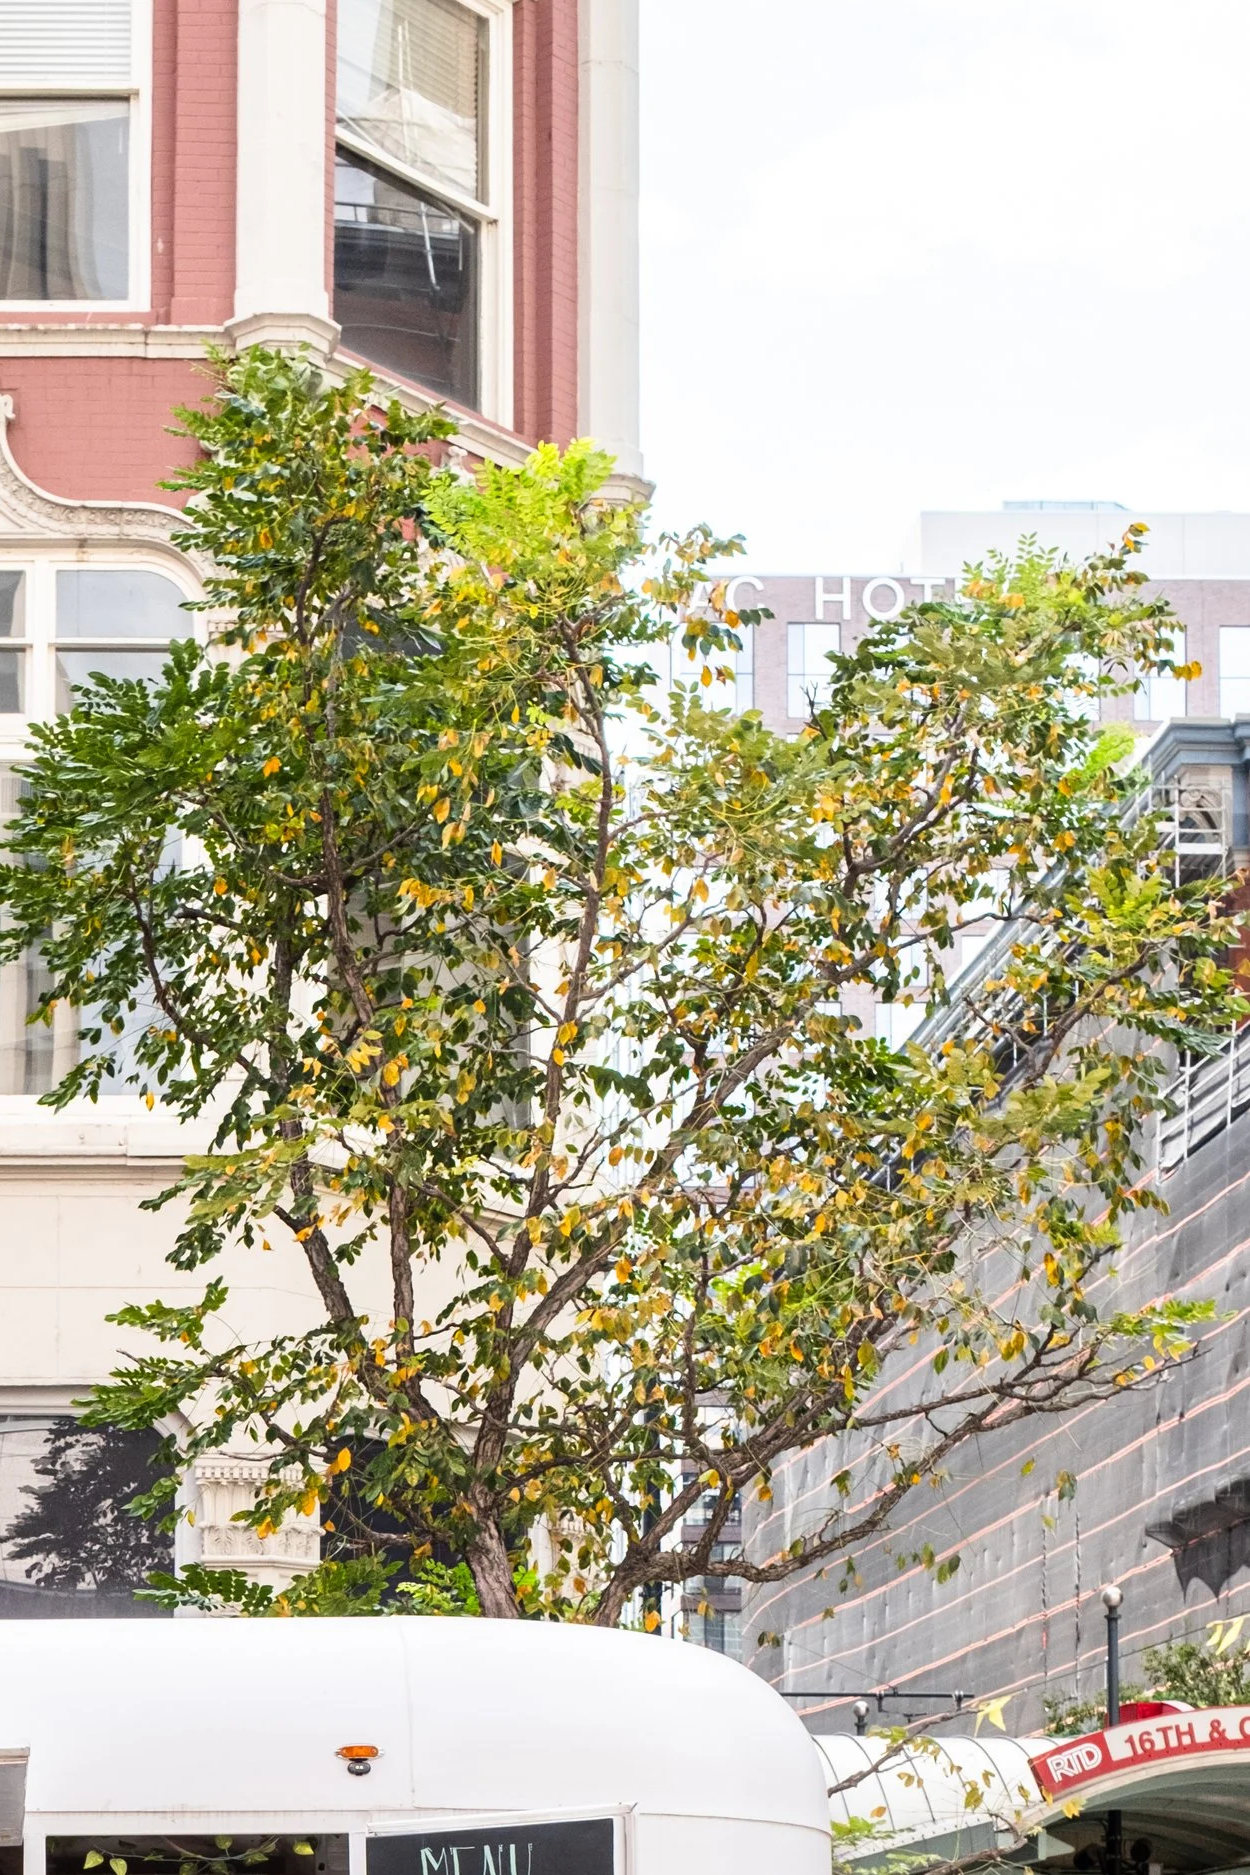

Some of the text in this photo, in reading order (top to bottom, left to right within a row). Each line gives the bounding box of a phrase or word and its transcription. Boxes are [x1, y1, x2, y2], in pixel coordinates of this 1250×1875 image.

[1124, 1722, 1196, 1756] 16TH
[1208, 1719, 1229, 1741] &
[1046, 1743, 1102, 1783] RTD
